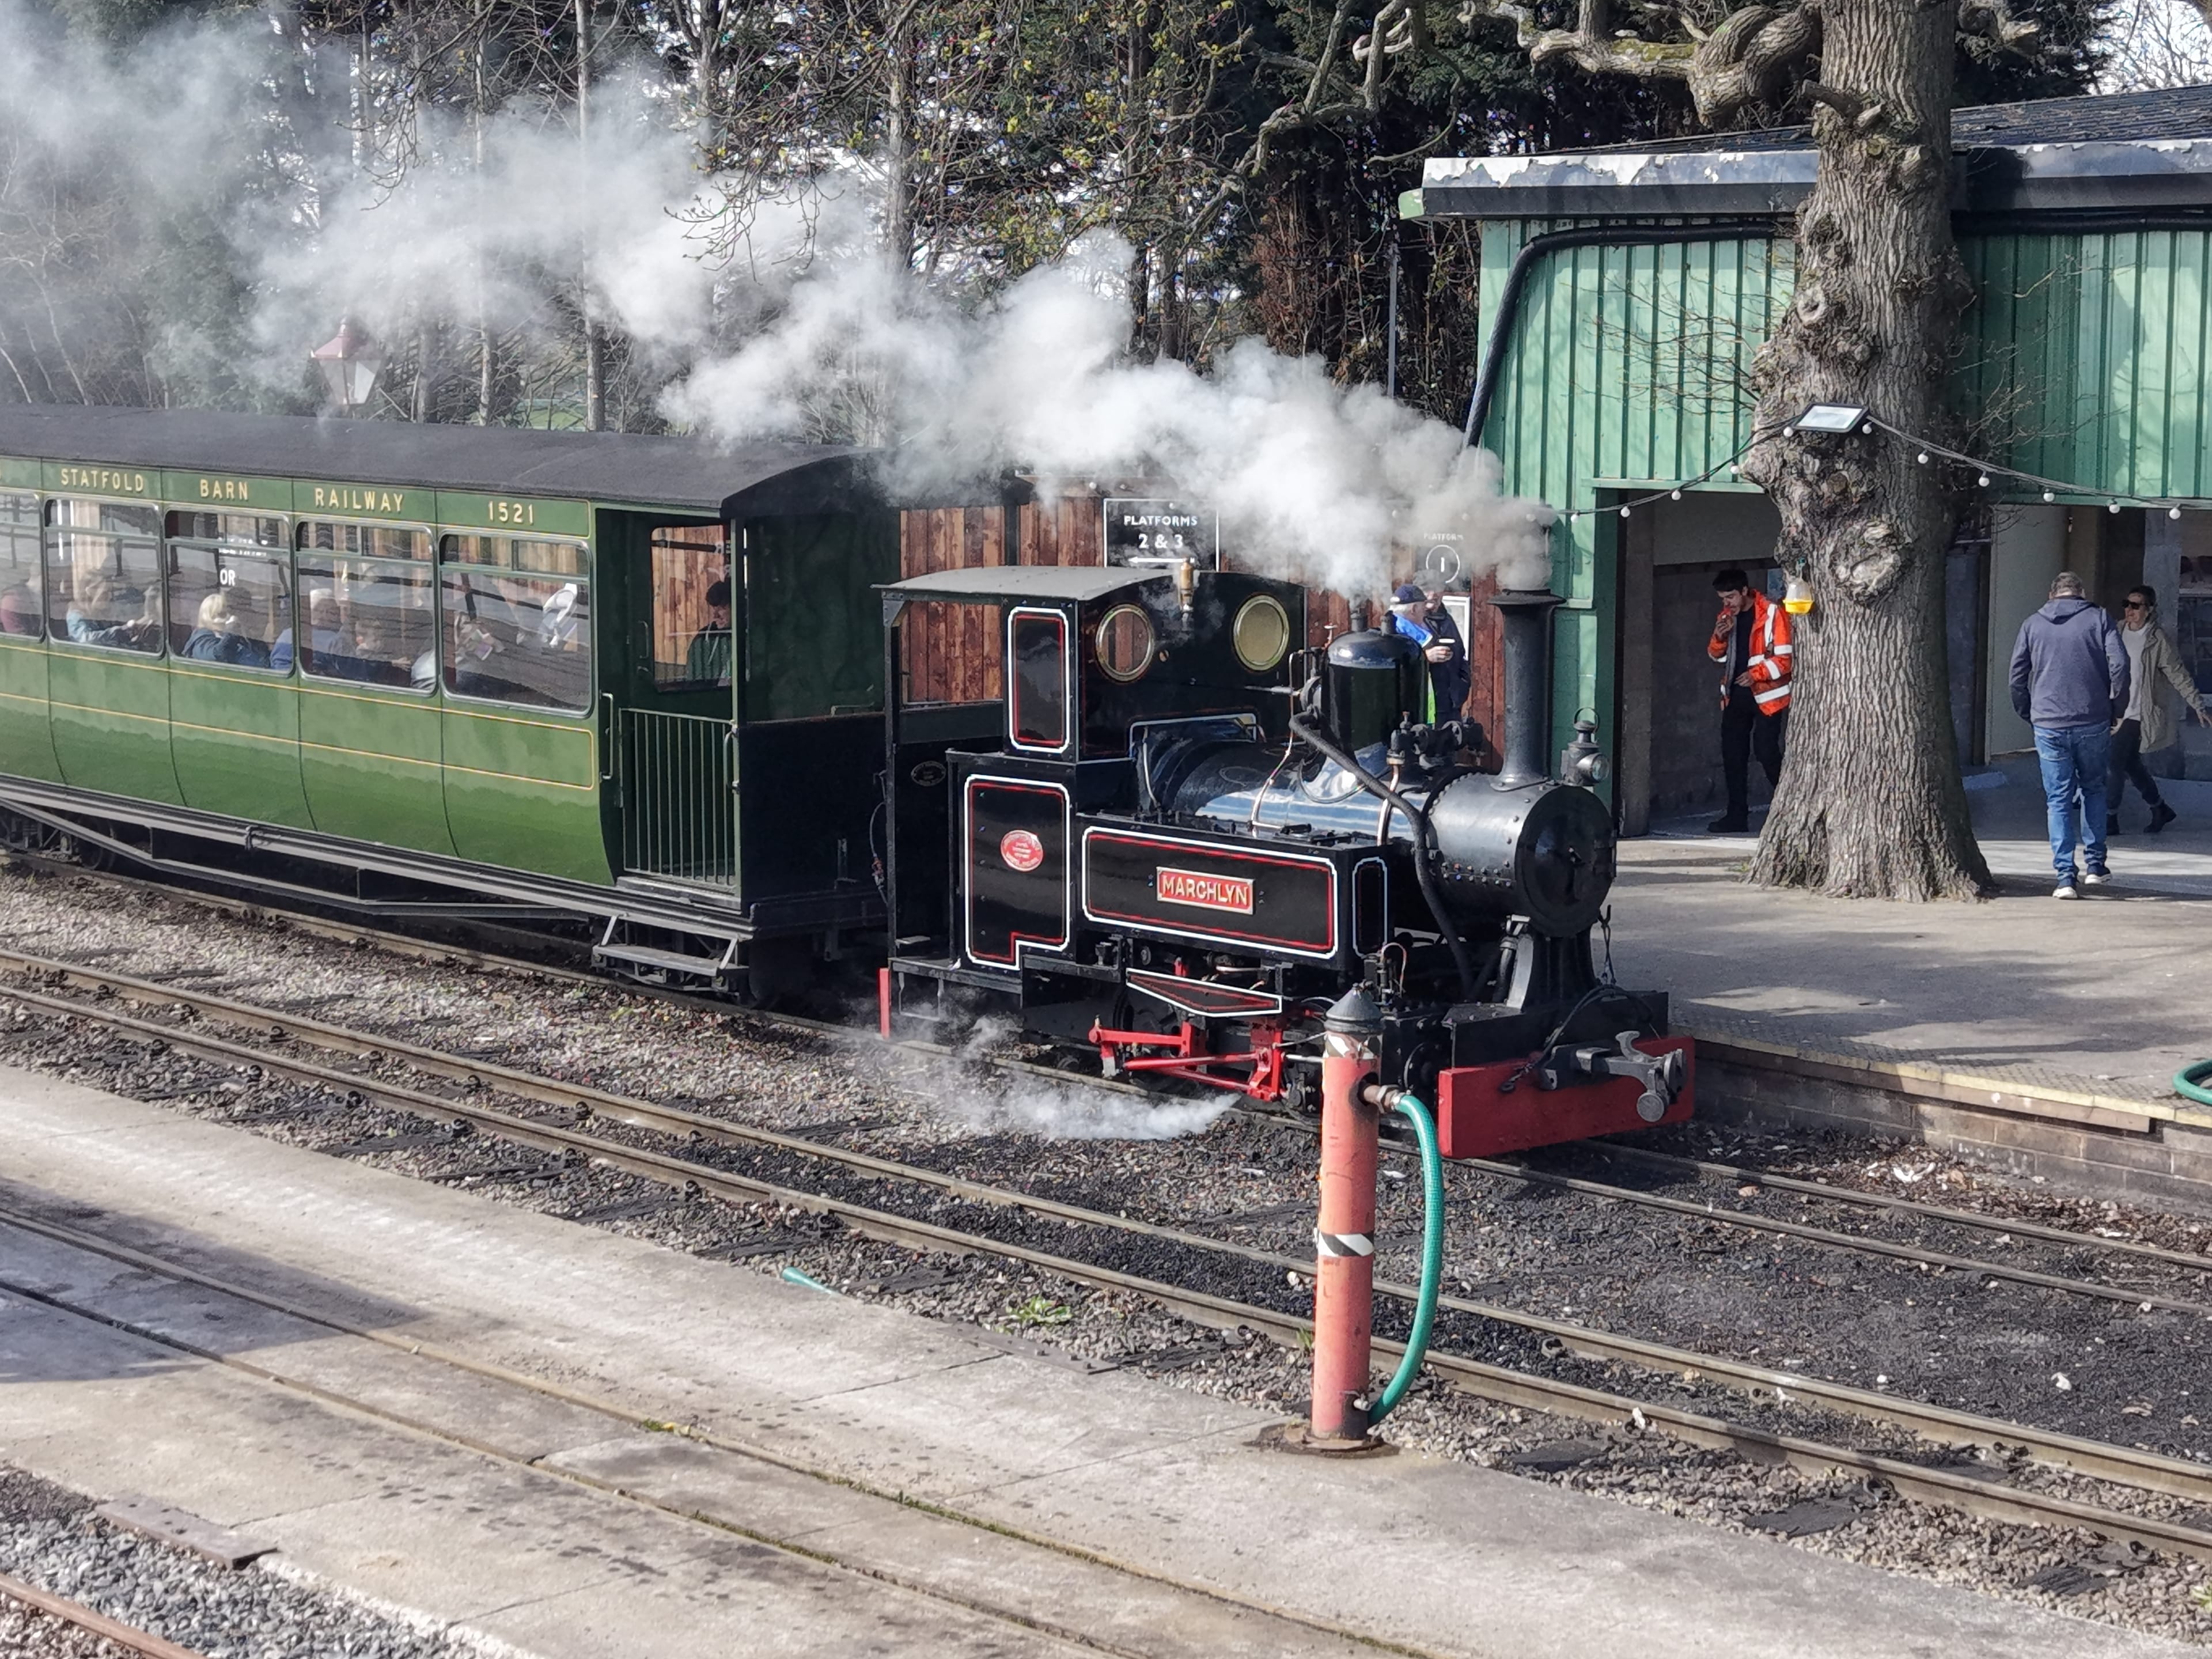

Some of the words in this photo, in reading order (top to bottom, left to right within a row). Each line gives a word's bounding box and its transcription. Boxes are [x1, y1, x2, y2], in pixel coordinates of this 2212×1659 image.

[61, 468, 143, 491] STATFOLD
[200, 479, 248, 500] BARN
[315, 488, 403, 512] RAILWAY
[488, 501, 533, 524] 1521
[1124, 515, 1198, 527] PLATFORMS
[1138, 533, 1149, 548] 2
[1154, 534, 1168, 548] &
[1174, 534, 1183, 548] 3
[219, 569, 236, 586] OR
[1162, 875, 1248, 906] MARCHLYN
